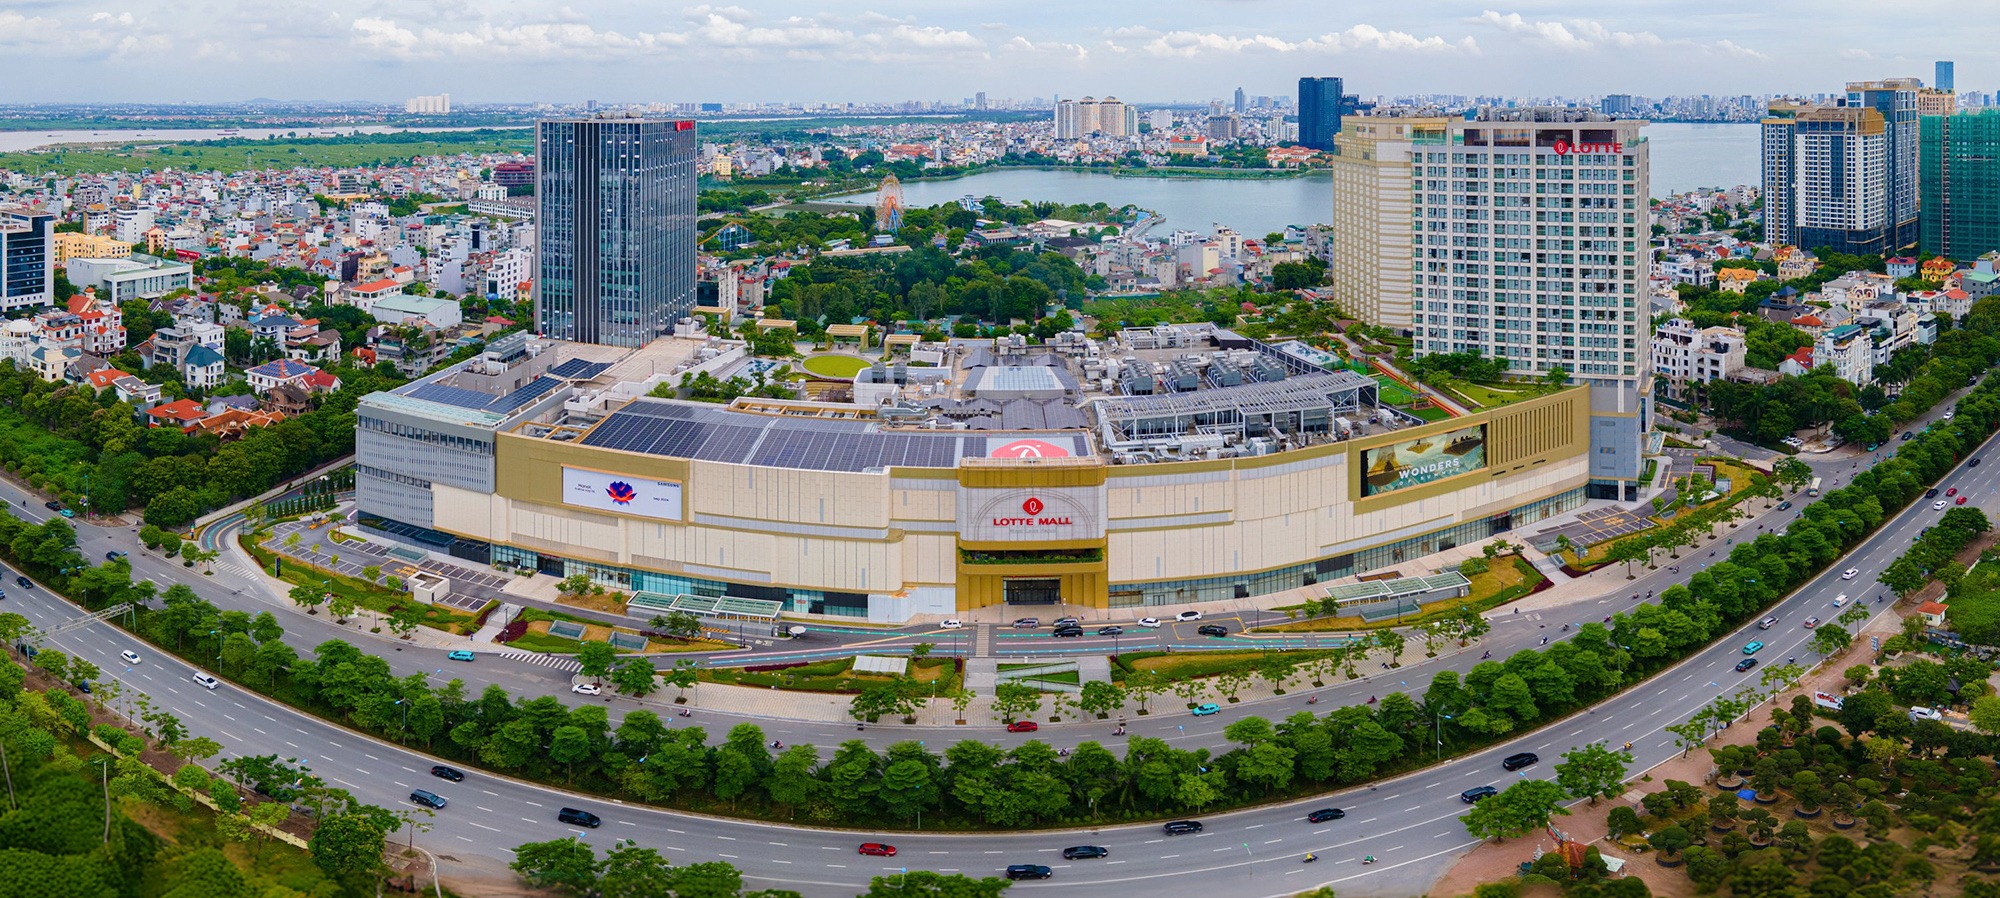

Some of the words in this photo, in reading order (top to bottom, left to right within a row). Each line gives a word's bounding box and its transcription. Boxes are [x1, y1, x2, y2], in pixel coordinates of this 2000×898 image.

[1571, 142, 1622, 153] LOTTE
[1398, 458, 1460, 479] WONDERS
[993, 518, 1034, 526] LOTTE
[1038, 517, 1072, 525] MALL
